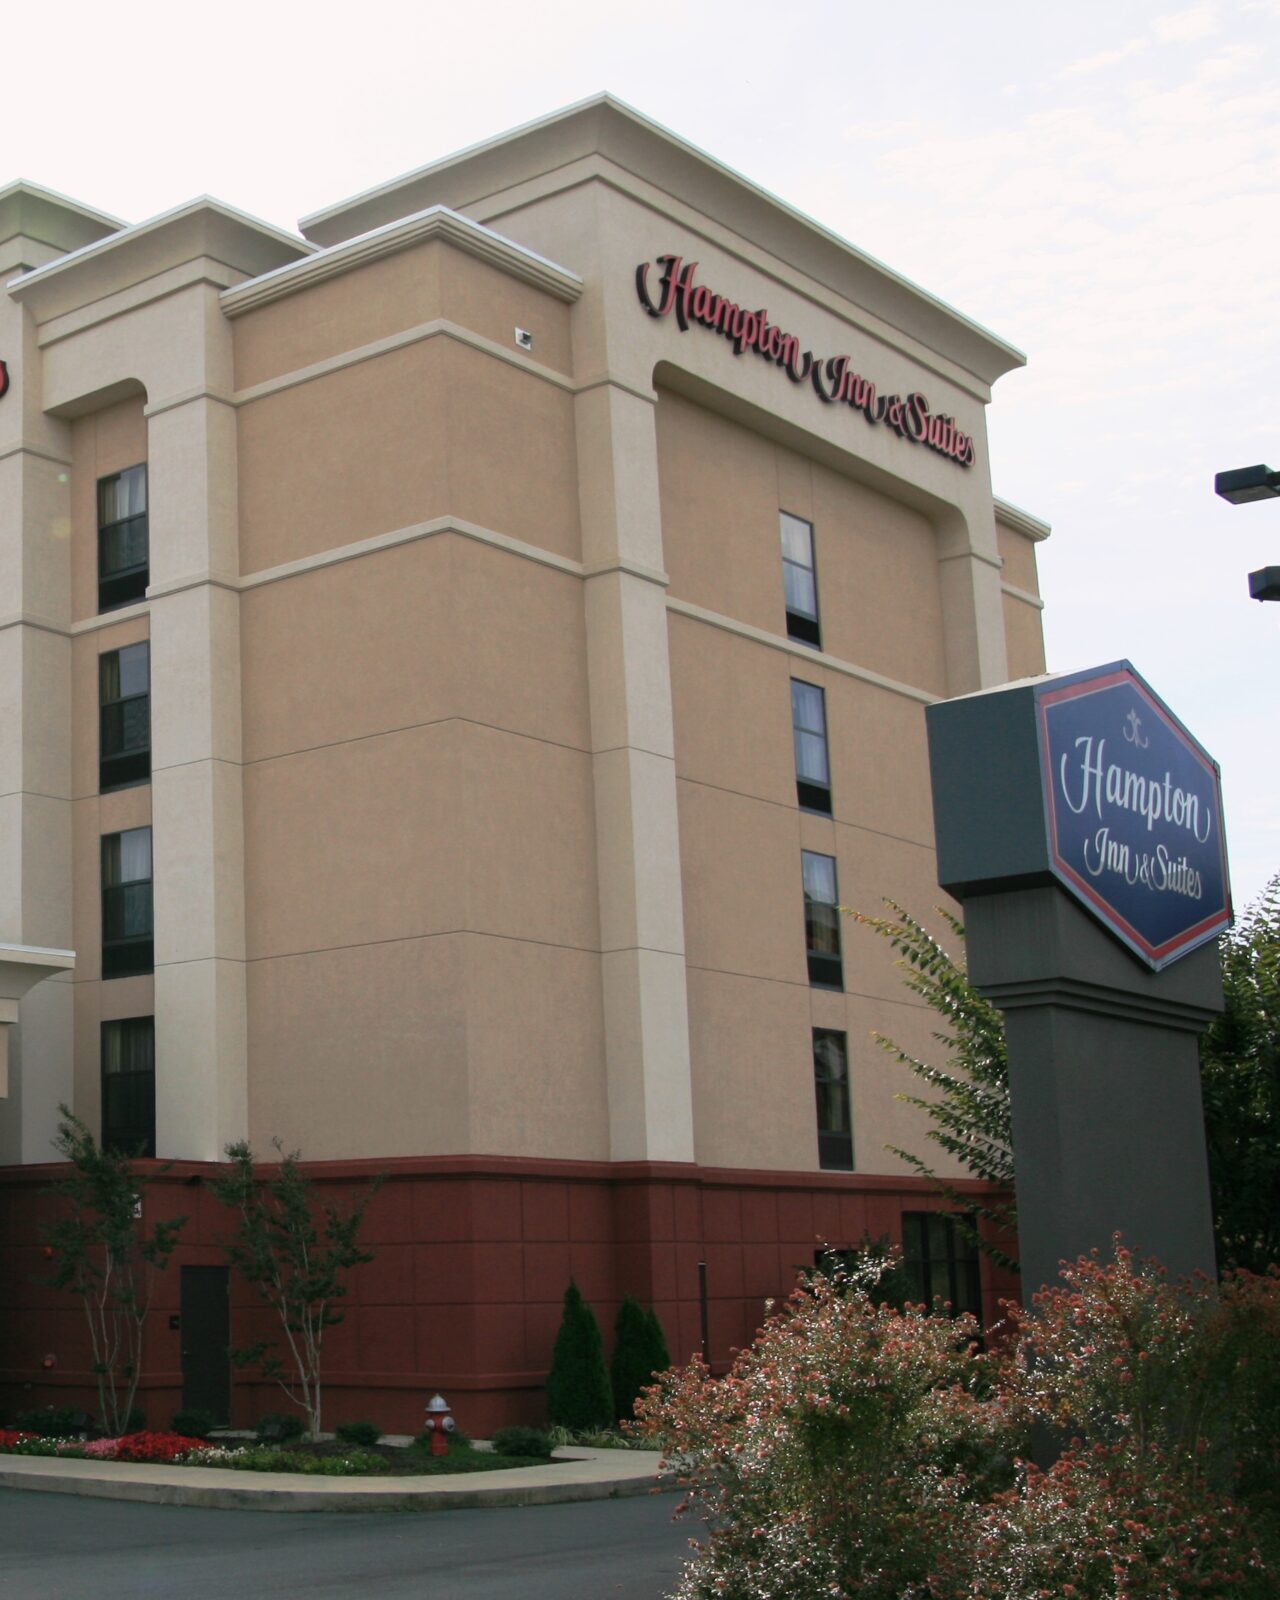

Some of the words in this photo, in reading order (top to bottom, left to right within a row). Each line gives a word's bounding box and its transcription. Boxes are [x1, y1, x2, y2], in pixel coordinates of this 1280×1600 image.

[635, 254, 813, 384] Hampton
[811, 355, 888, 425] Inn
[885, 394, 908, 438] &
[904, 391, 976, 467] Suites
[1060, 736, 1210, 843] Hampton
[1083, 827, 1139, 885] Inn
[1139, 853, 1154, 891] &
[1150, 844, 1202, 900] Suites
